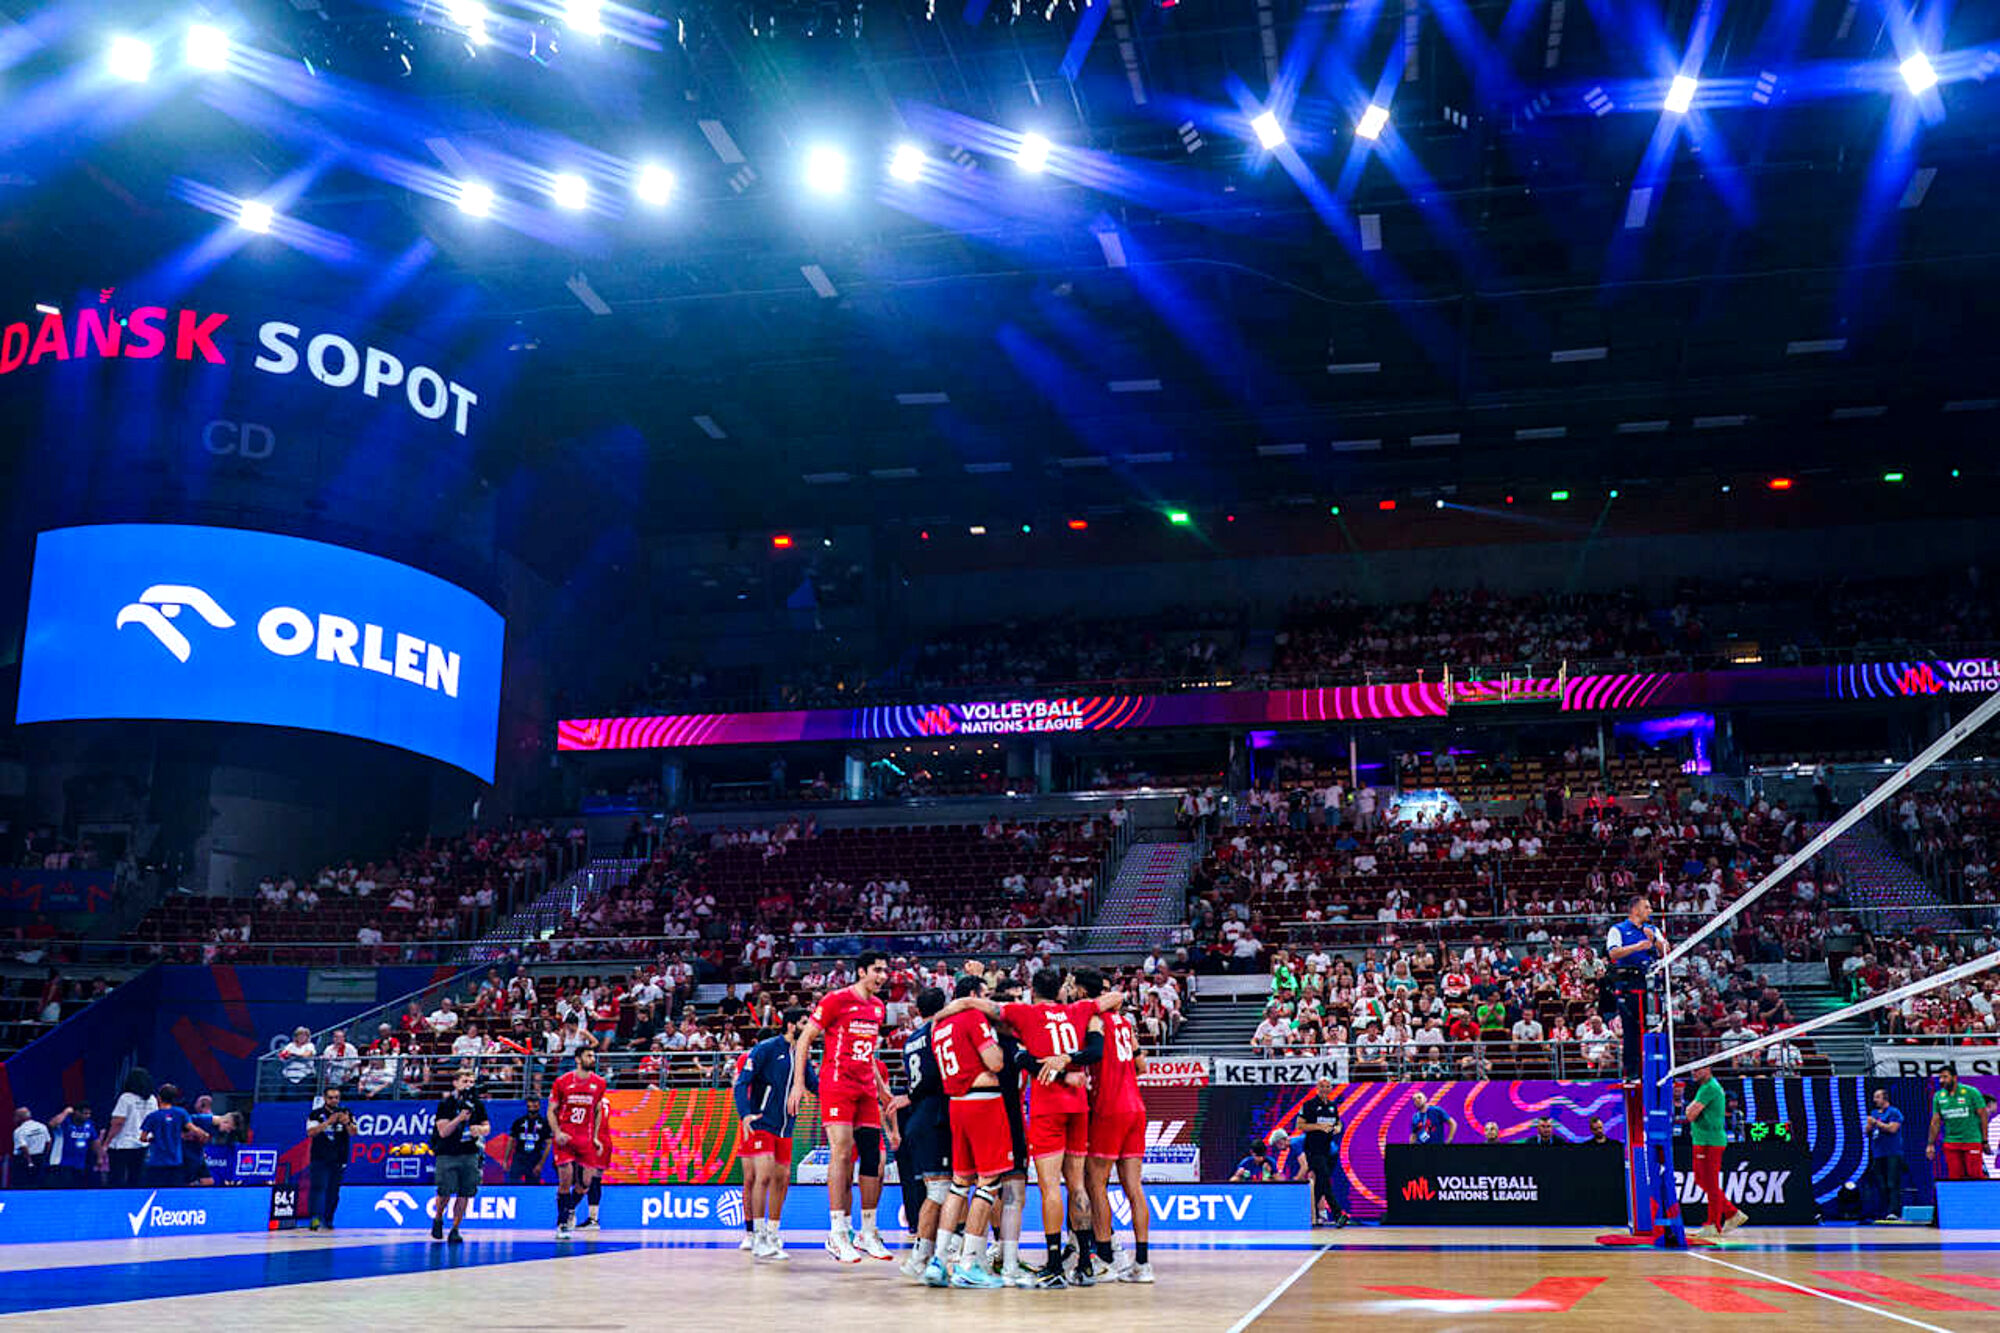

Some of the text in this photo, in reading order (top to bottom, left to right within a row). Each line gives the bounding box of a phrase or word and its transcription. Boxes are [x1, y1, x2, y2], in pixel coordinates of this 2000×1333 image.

[254, 321, 478, 436] SOPOT
[201, 420, 276, 459] CD
[257, 606, 461, 699] ORLEN
[960, 700, 1083, 720] VOLLEYBALL
[961, 717, 1083, 734] NATIONS LEAGUE
[1044, 1021, 1079, 1055] 10
[851, 1040, 873, 1062] 52
[935, 1037, 959, 1080] 15
[570, 1107, 586, 1124] 20
[1437, 1176, 1538, 1190] VOLLEYBALL
[1438, 1190, 1539, 1201] NATIONS LEAGUE
[150, 1206, 207, 1227] Rexona
[641, 1191, 710, 1226] plus
[1150, 1195, 1252, 1221] VBTV
